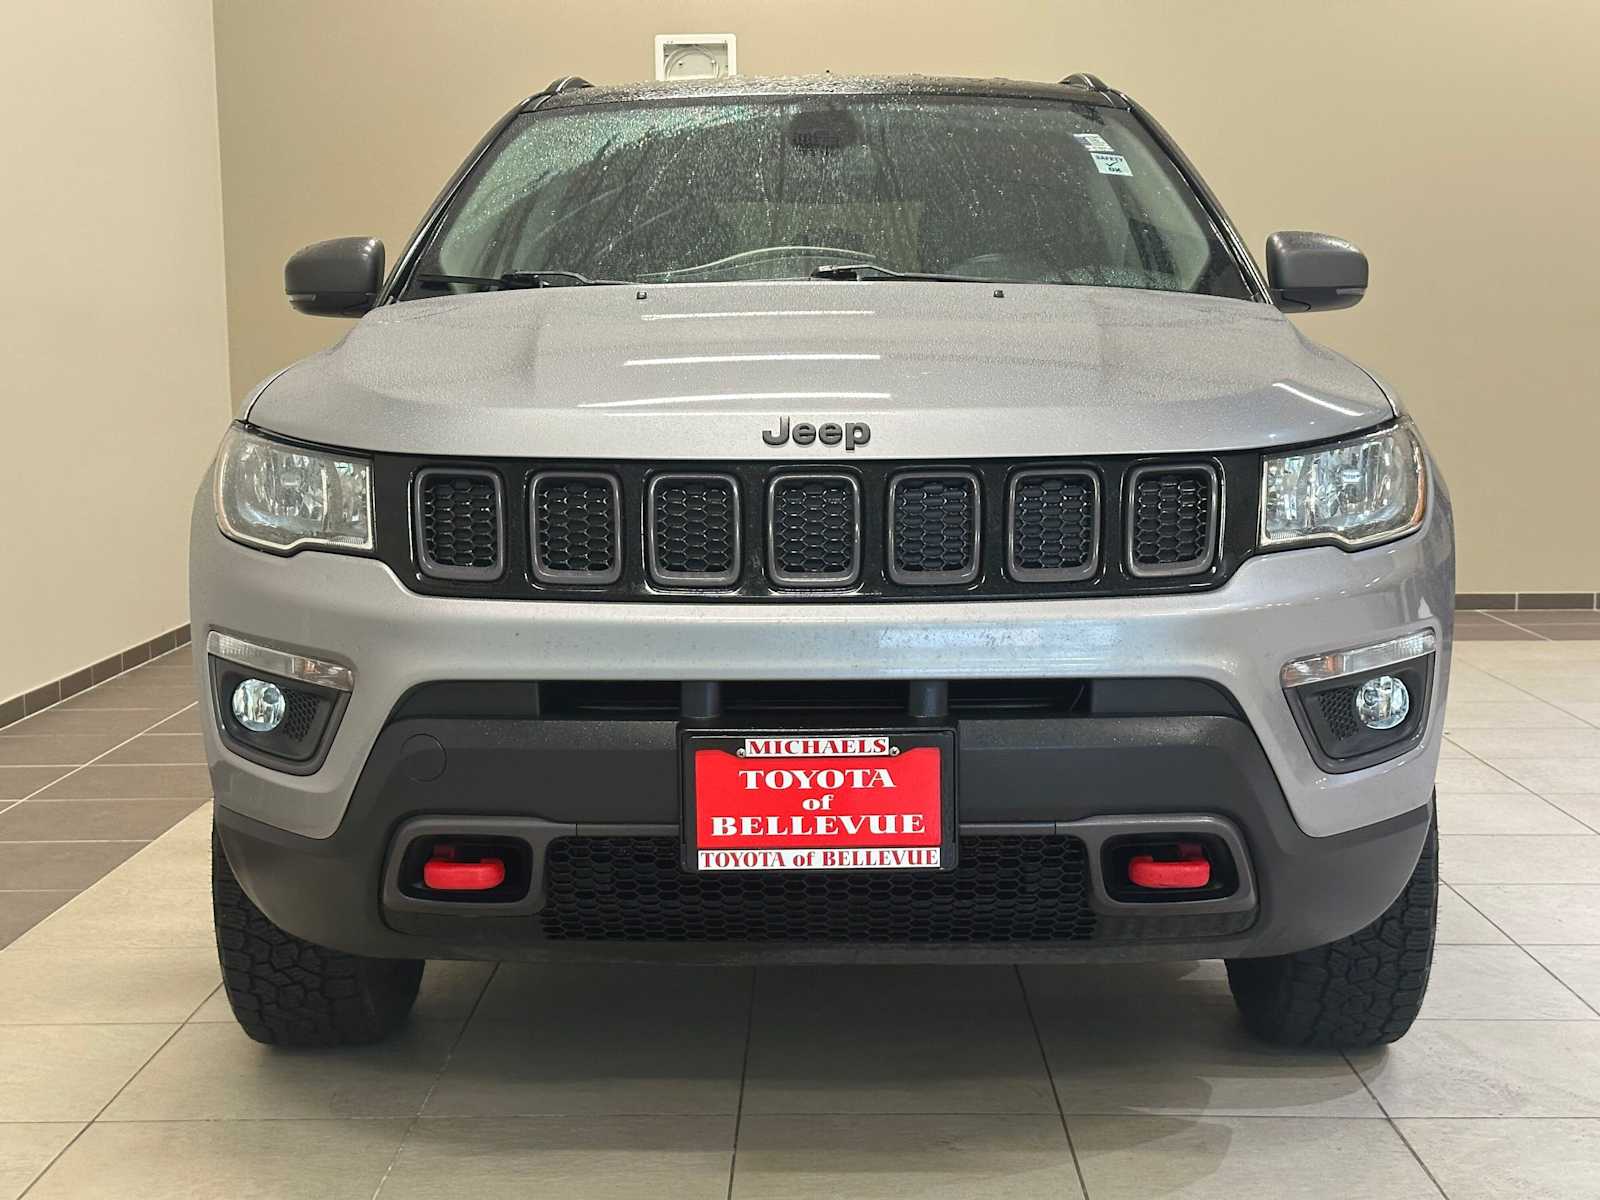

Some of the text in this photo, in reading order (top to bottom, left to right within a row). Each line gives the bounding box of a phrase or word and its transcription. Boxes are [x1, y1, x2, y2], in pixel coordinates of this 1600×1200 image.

[762, 416, 871, 450] Jeep
[749, 739, 887, 755] MICHAELS
[738, 768, 896, 790] TOYOTA
[802, 794, 834, 811] of
[711, 814, 925, 836] BELLEVUE
[700, 849, 939, 868] TOYOTA of BELLEVUE
